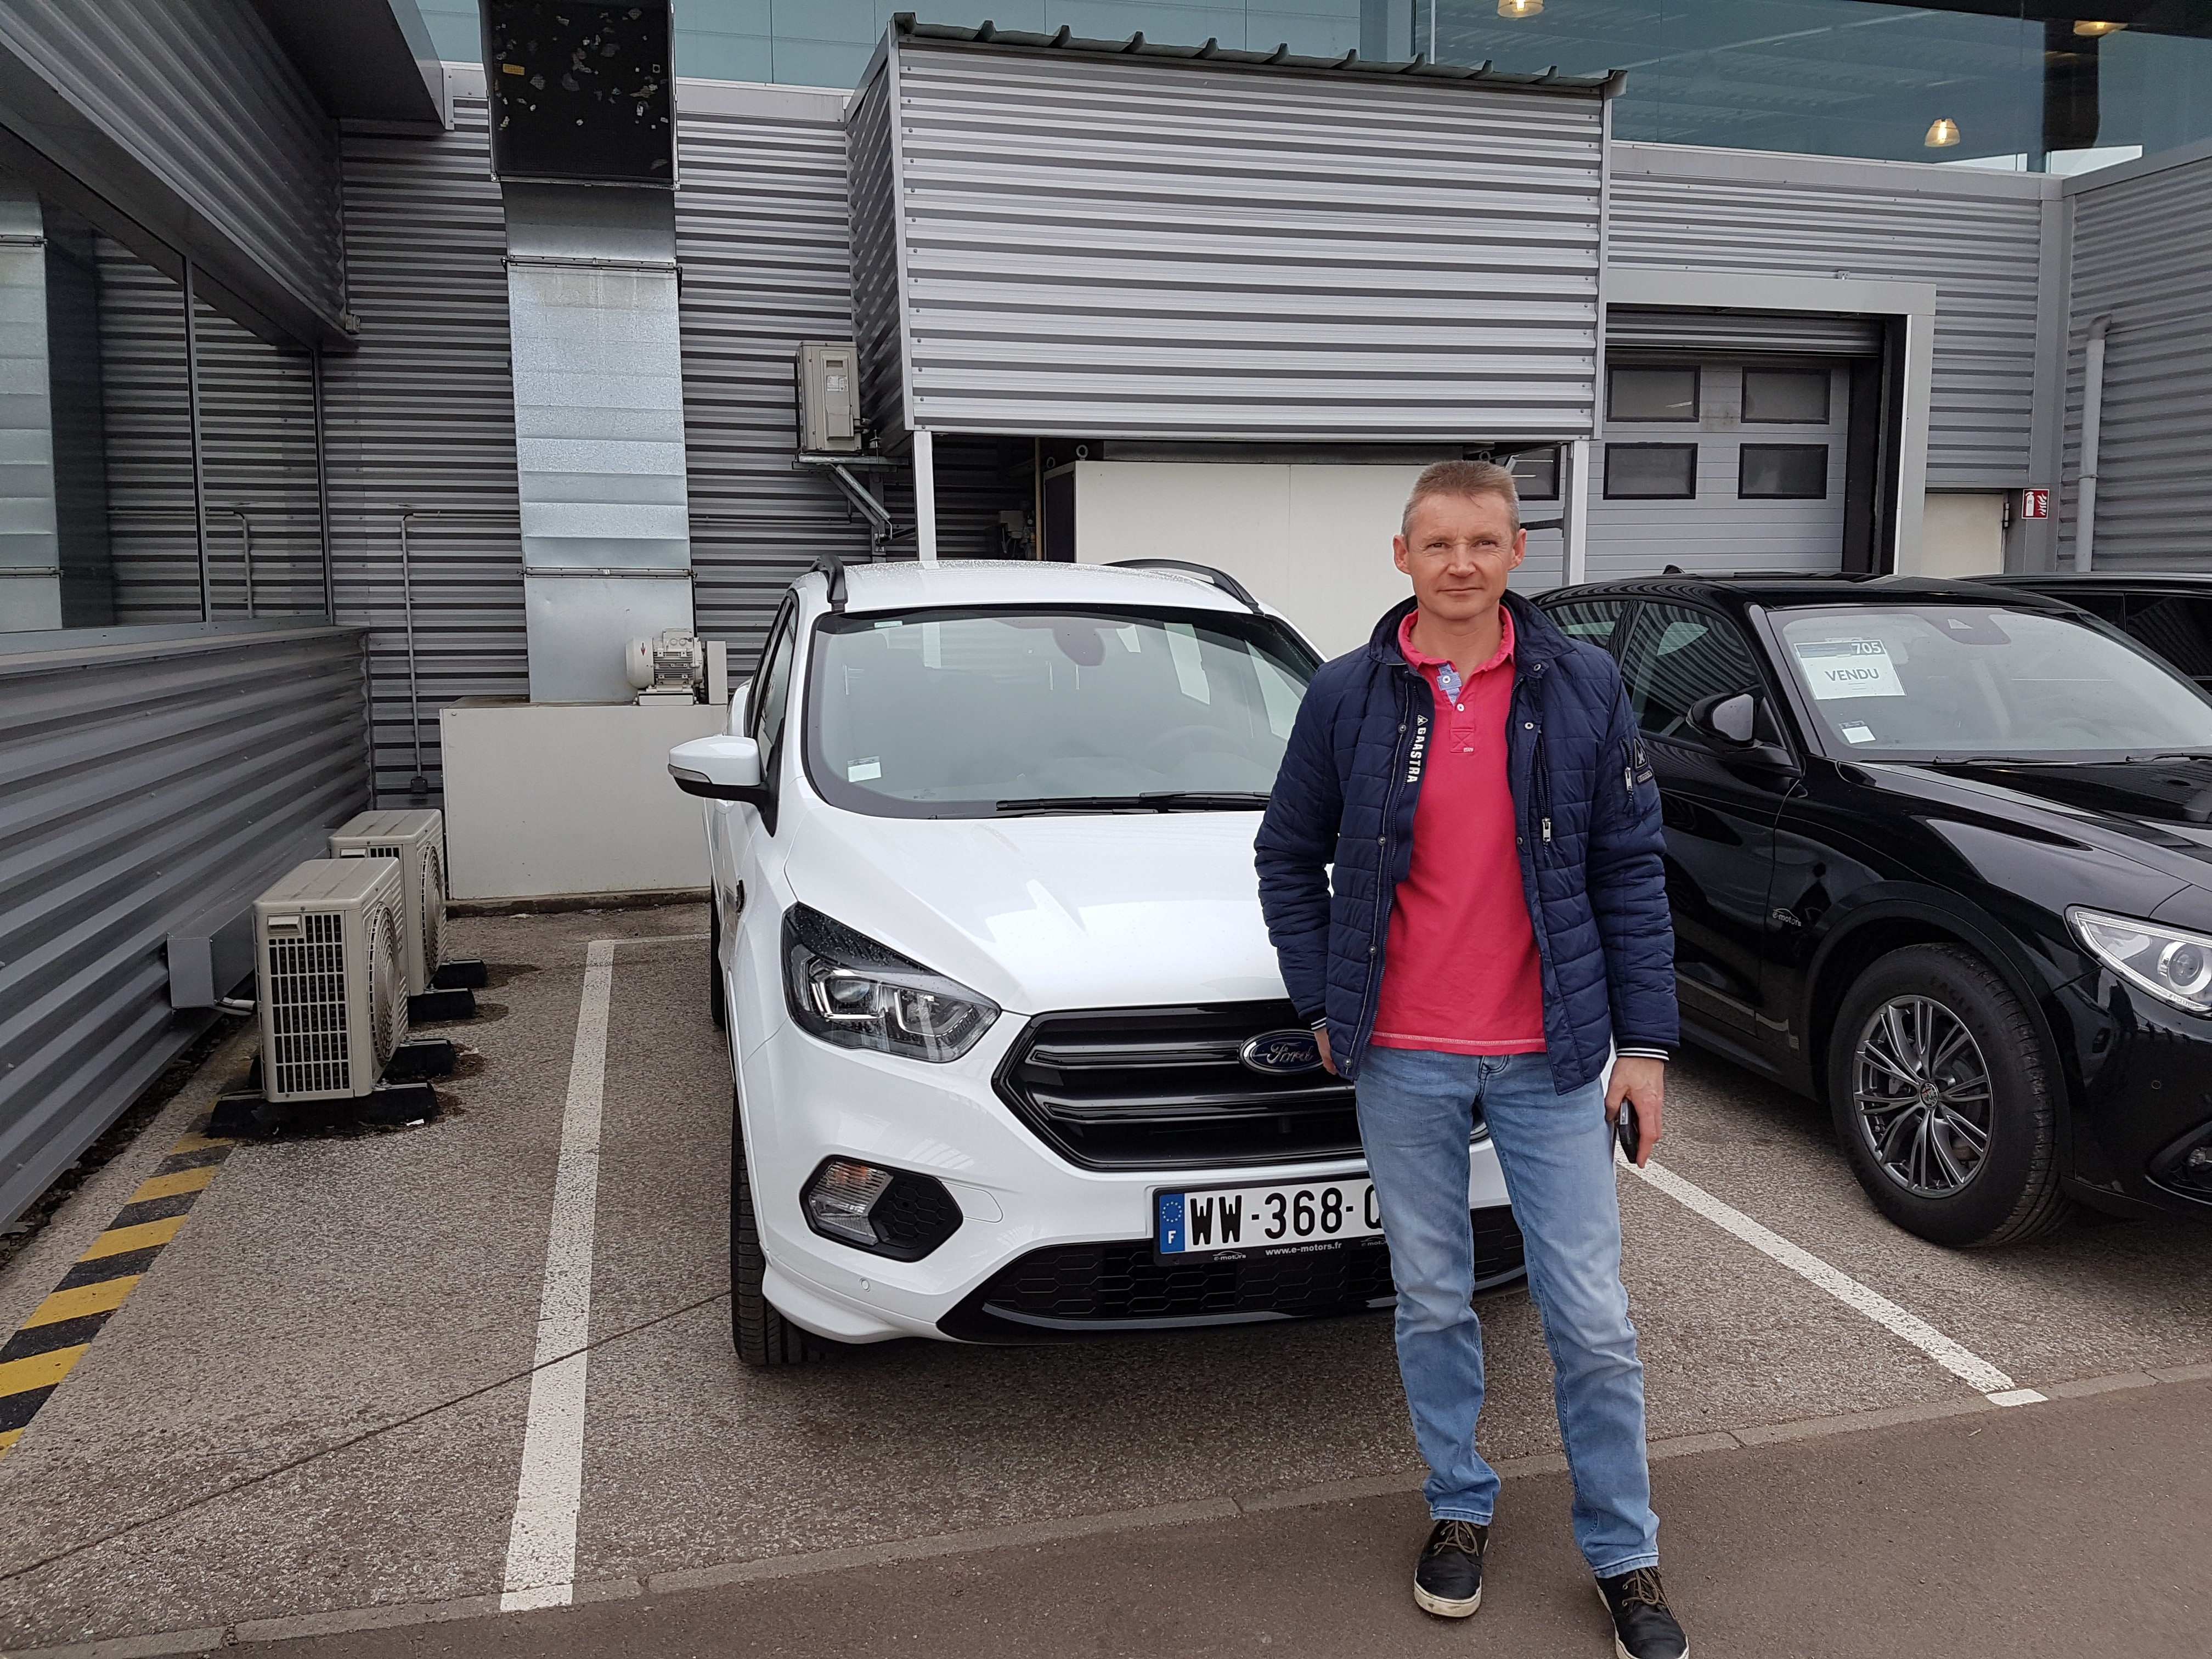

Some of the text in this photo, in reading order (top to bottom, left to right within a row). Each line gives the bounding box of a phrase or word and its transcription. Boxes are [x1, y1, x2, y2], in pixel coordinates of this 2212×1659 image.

[1851, 642, 1882, 654] 705
[1825, 668, 1880, 681] VENDU
[1407, 727, 1426, 783] GAASTRA
[1267, 1042, 1314, 1064] Ford
[1189, 1184, 1383, 1246] WW-368-Q
[1167, 1231, 1176, 1244] F
[1265, 1241, 1342, 1256] www.e-motors.fr
